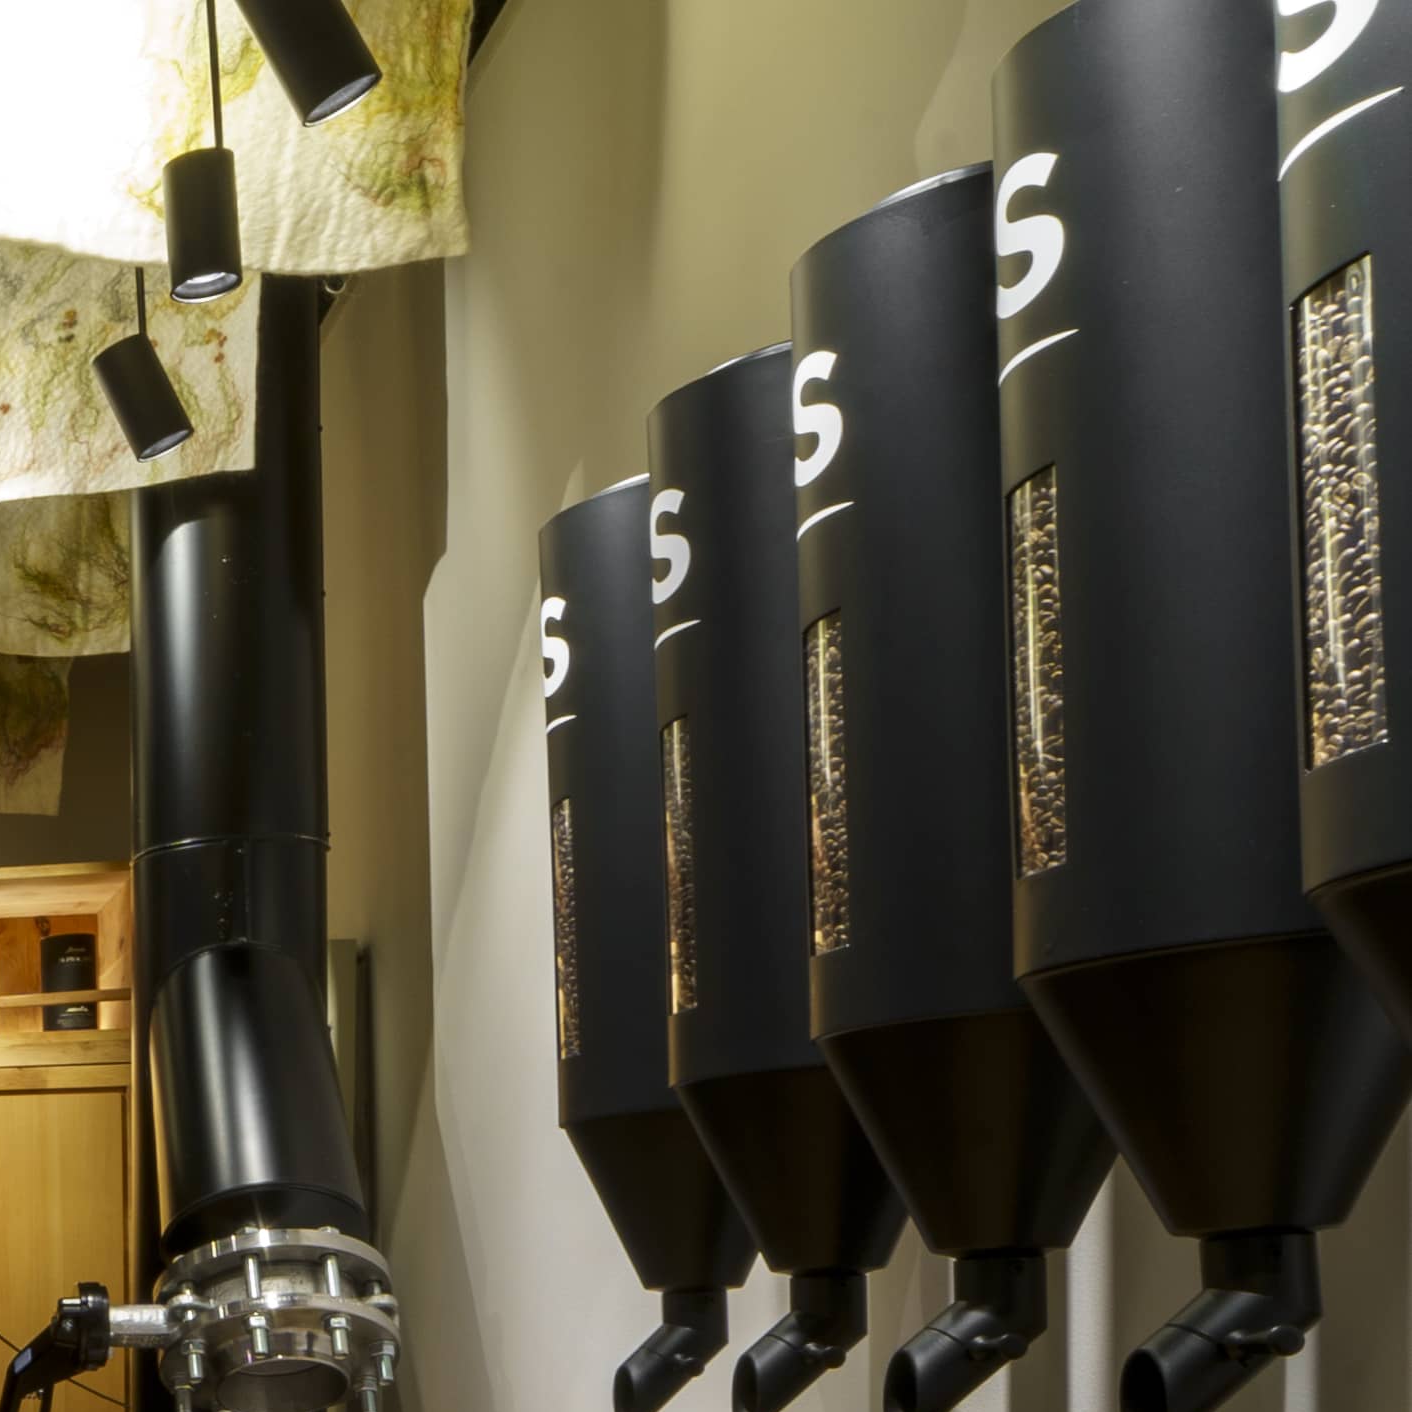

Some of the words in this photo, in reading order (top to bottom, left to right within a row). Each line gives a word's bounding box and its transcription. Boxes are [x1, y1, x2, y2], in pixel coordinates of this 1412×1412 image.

[994, 152, 1066, 320] S
[793, 349, 844, 488] S
[650, 488, 691, 606] S
[541, 595, 570, 697] S
